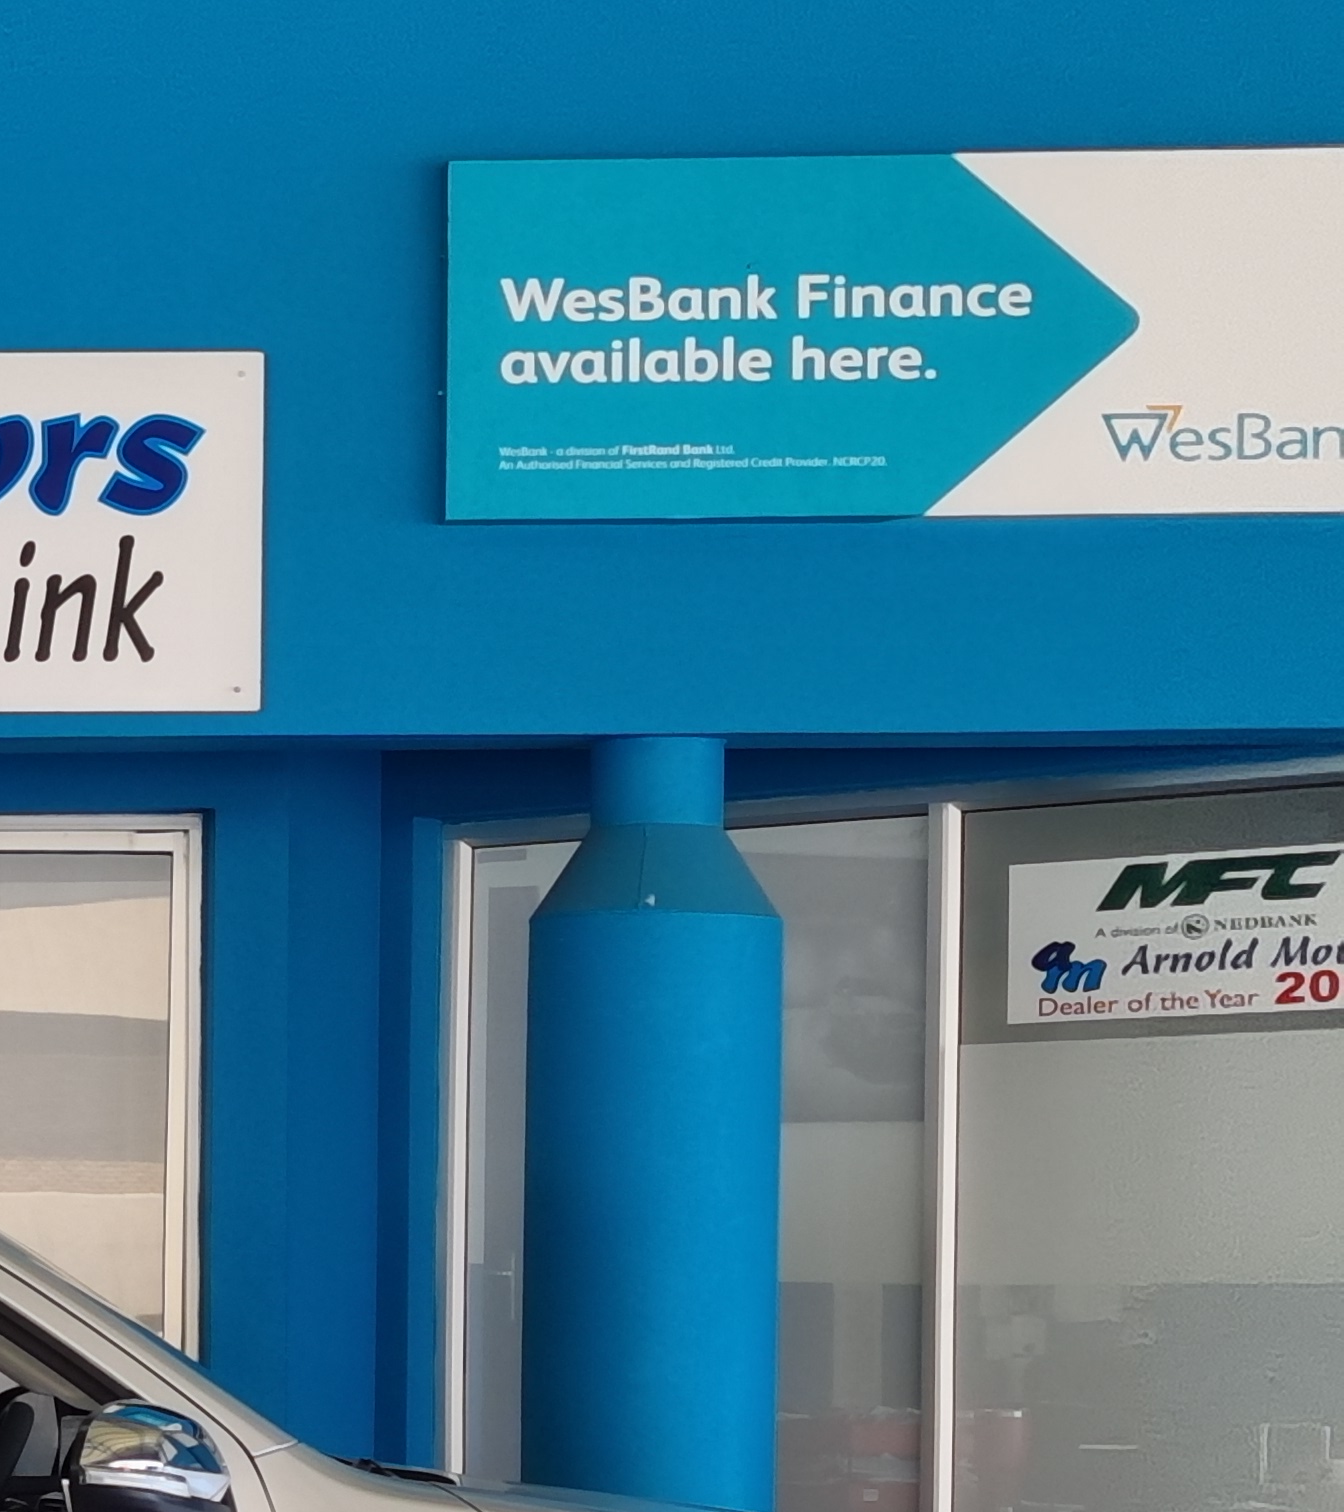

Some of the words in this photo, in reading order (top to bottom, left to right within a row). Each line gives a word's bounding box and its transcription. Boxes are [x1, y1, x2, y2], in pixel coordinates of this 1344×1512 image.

[501, 275, 777, 322] WesBank
[799, 274, 1032, 319] Finance
[500, 336, 772, 385] available
[792, 335, 937, 381] here.
[499, 446, 548, 457] WesBank
[565, 446, 606, 456] division
[608, 446, 620, 456] of
[622, 445, 680, 456] FirstRand
[683, 444, 714, 455] Bank
[499, 460, 513, 470] An
[516, 459, 573, 470] Authorised
[576, 459, 623, 470] Financial
[626, 459, 667, 469] Services
[670, 458, 691, 469] and
[693, 457, 749, 470] Registered
[751, 457, 783, 468] Credit
[1095, 850, 1343, 912] MFC
[1095, 927, 1107, 939] A
[1110, 924, 1161, 938] division
[1165, 922, 1178, 935] of
[1213, 913, 1318, 932] NEDBANK
[1121, 936, 1260, 977] Arnold
[1038, 995, 1120, 1017] Dealer
[1127, 991, 1154, 1014] of
[1161, 991, 1200, 1012] the
[1204, 988, 1261, 1010] Year
